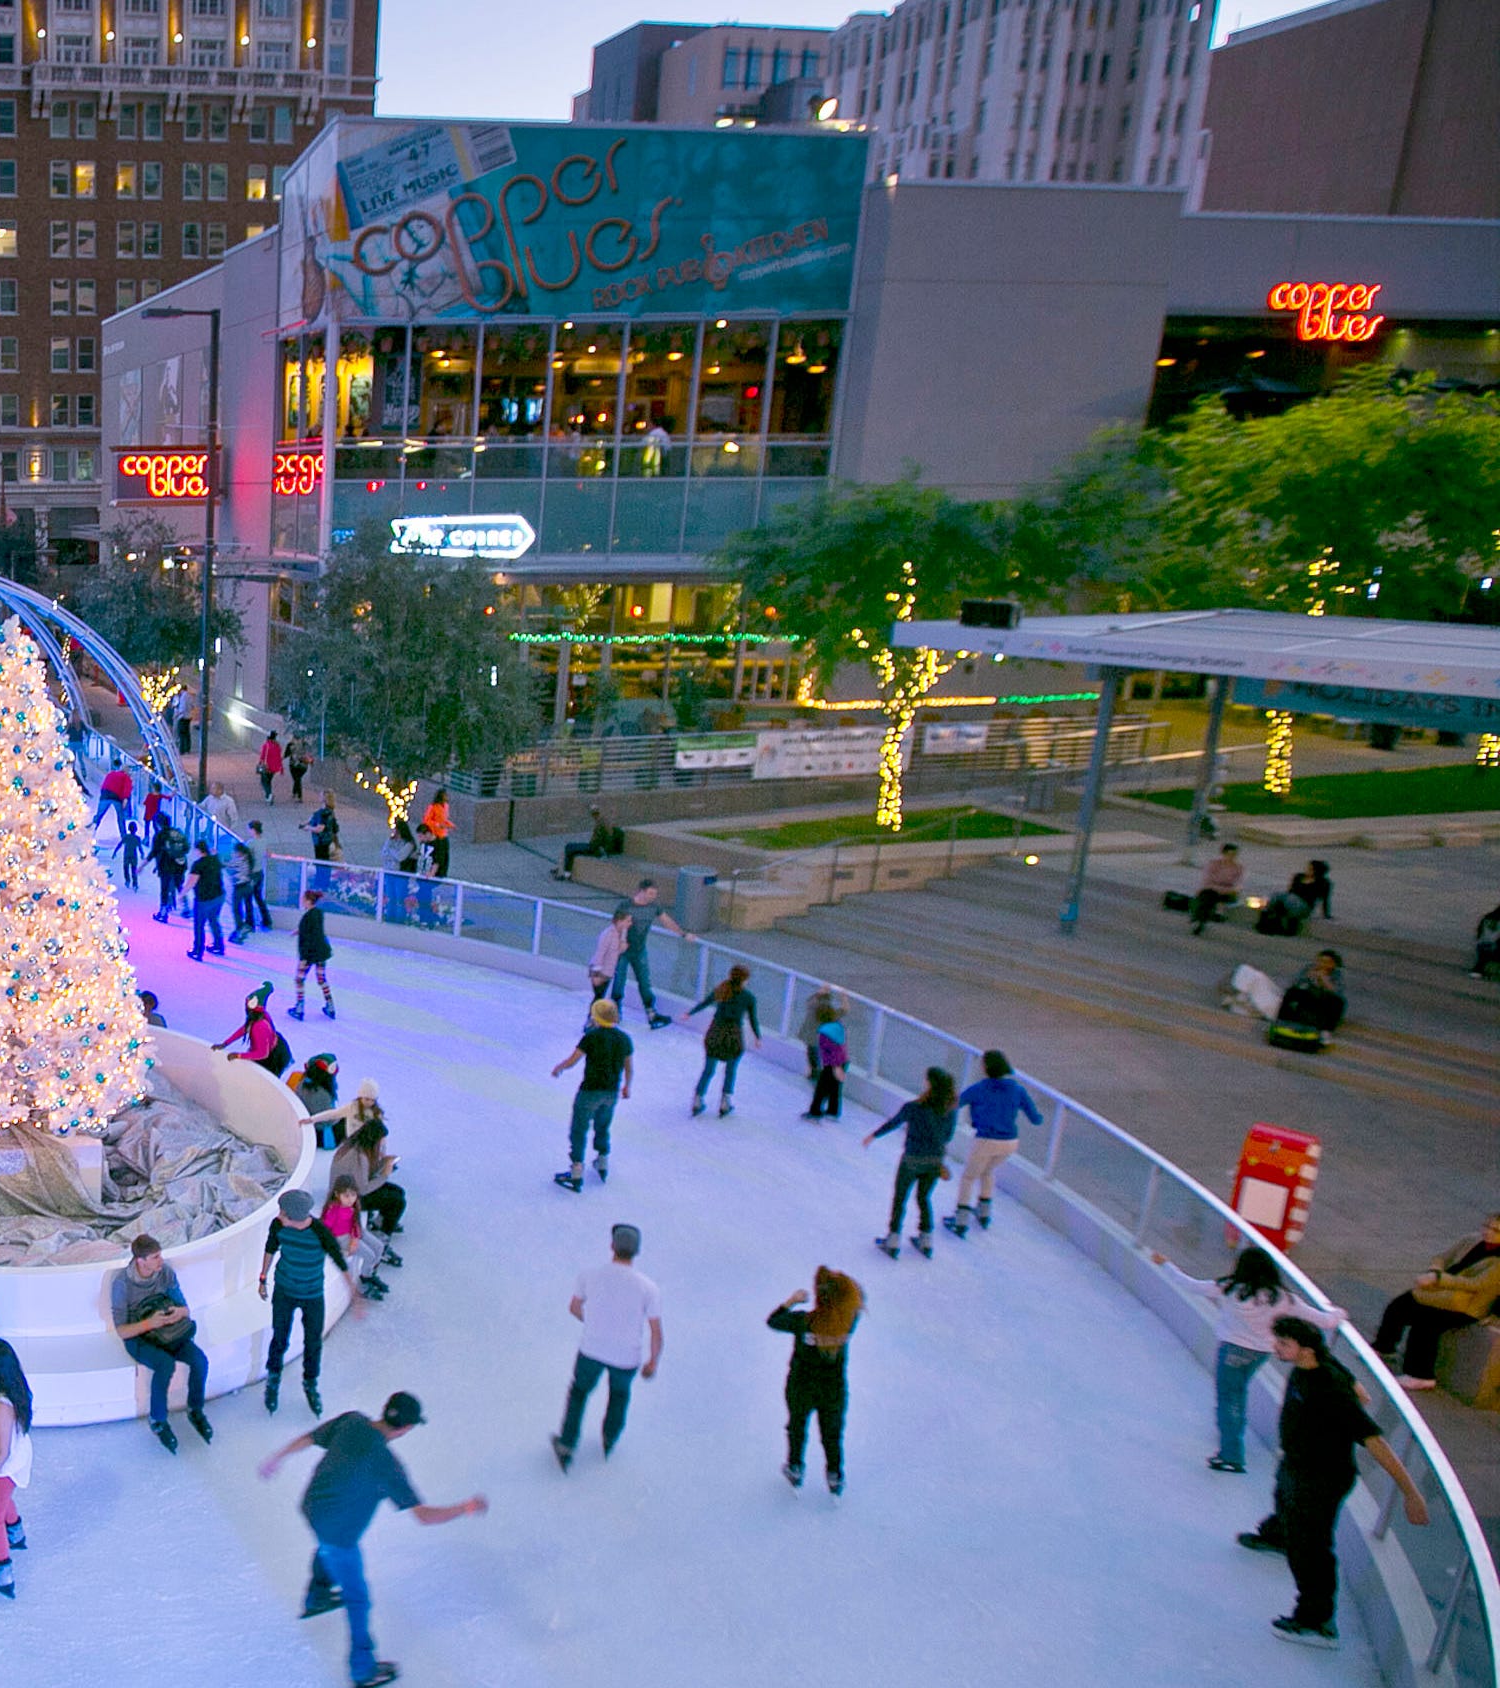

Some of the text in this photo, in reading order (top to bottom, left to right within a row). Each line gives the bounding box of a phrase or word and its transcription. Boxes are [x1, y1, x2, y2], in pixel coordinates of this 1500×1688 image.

[359, 188, 398, 214] LIVE
[402, 163, 460, 194] MUSIC
[352, 137, 627, 290] copper
[448, 196, 672, 313] blues
[591, 273, 653, 309] ROCK
[656, 258, 702, 289] PUB
[732, 217, 829, 266] KITCHEN
[1267, 282, 1382, 311] copper
[1297, 312, 1386, 341] blues
[120, 454, 209, 478] copper
[146, 472, 210, 497] blue
